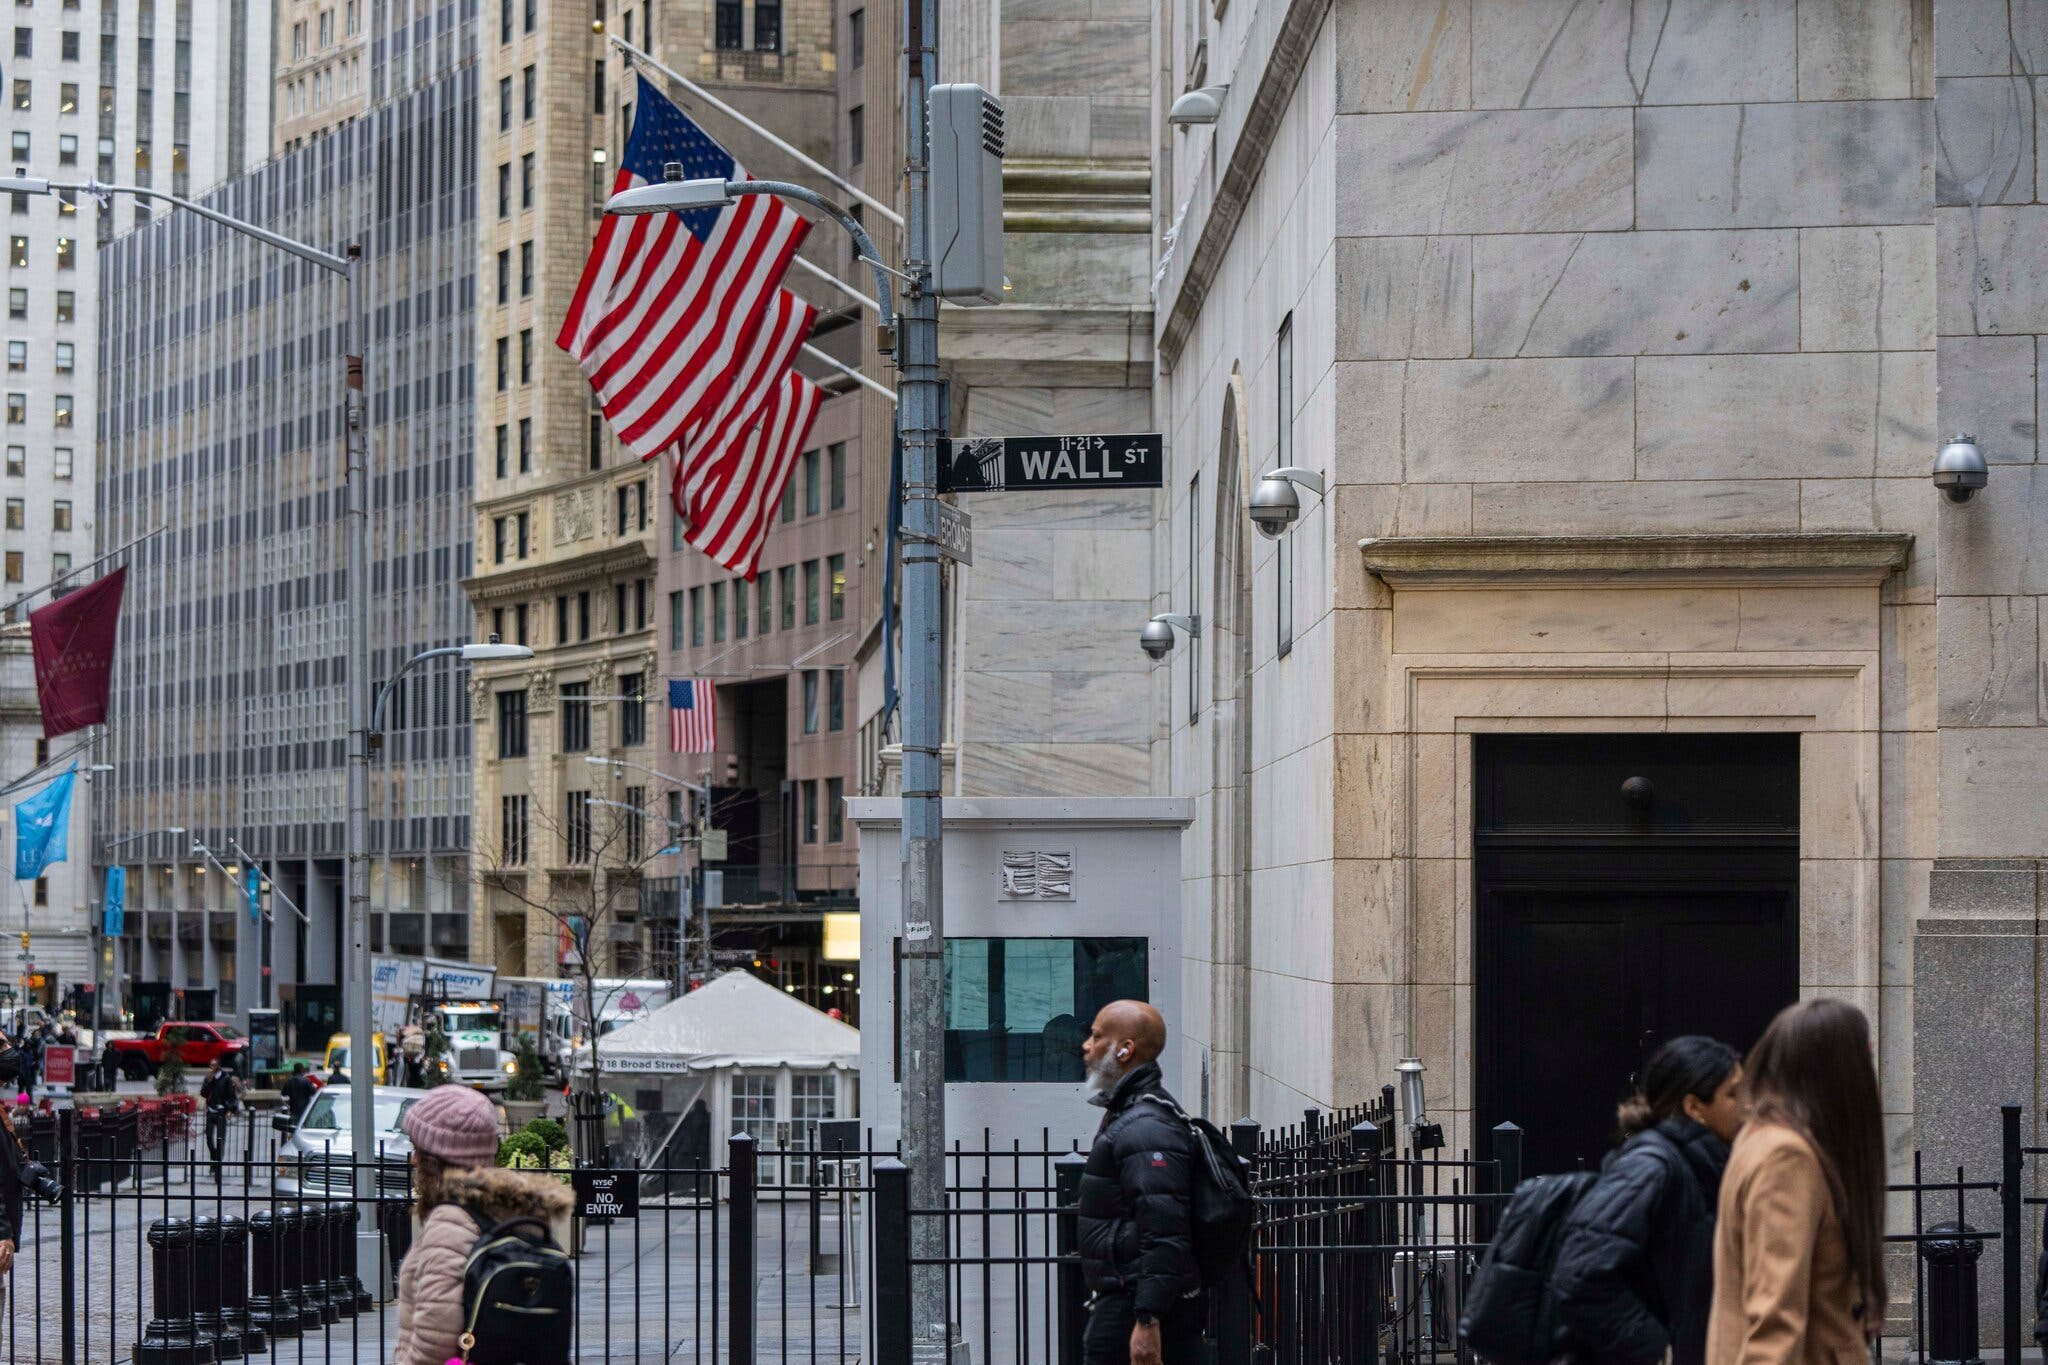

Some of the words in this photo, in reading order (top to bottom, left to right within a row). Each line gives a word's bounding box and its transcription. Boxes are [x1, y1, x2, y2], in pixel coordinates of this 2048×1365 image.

[1060, 437, 1091, 450] 11-21
[1020, 450, 1123, 480] WALL
[1125, 449, 1148, 463] ST
[941, 516, 967, 552] BROAD
[607, 1060, 617, 1068] 18
[621, 1060, 651, 1068] Broad
[655, 1060, 686, 1069] Street
[596, 1193, 614, 1203] NO
[586, 1203, 623, 1214] ENTRY
